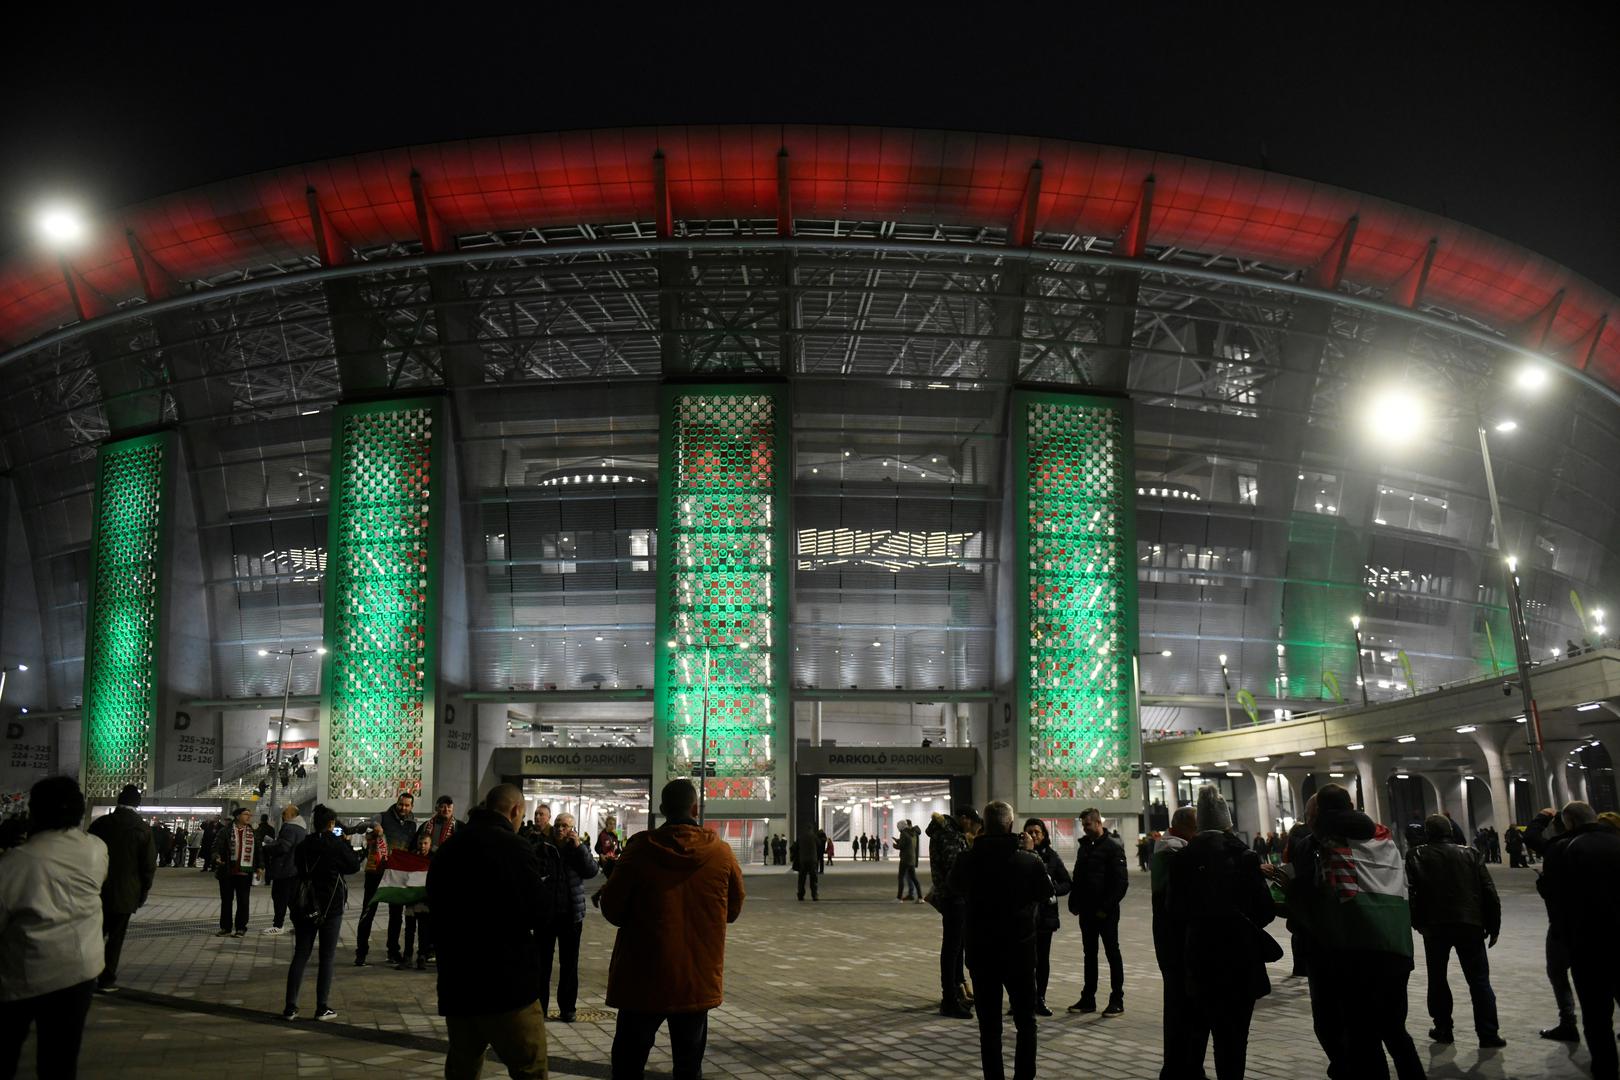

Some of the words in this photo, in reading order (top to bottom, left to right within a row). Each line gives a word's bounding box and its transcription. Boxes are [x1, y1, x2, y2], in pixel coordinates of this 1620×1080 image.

[174, 711, 191, 731] D
[445, 704, 455, 725] D
[6, 722, 24, 739] D
[177, 744, 215, 755] 225-226
[176, 754, 213, 764] 125-126
[525, 752, 581, 765] PARKOLÓ
[584, 753, 636, 765] PARKING
[829, 752, 887, 765] PARKOLÓ
[891, 754, 944, 765] PARKING
